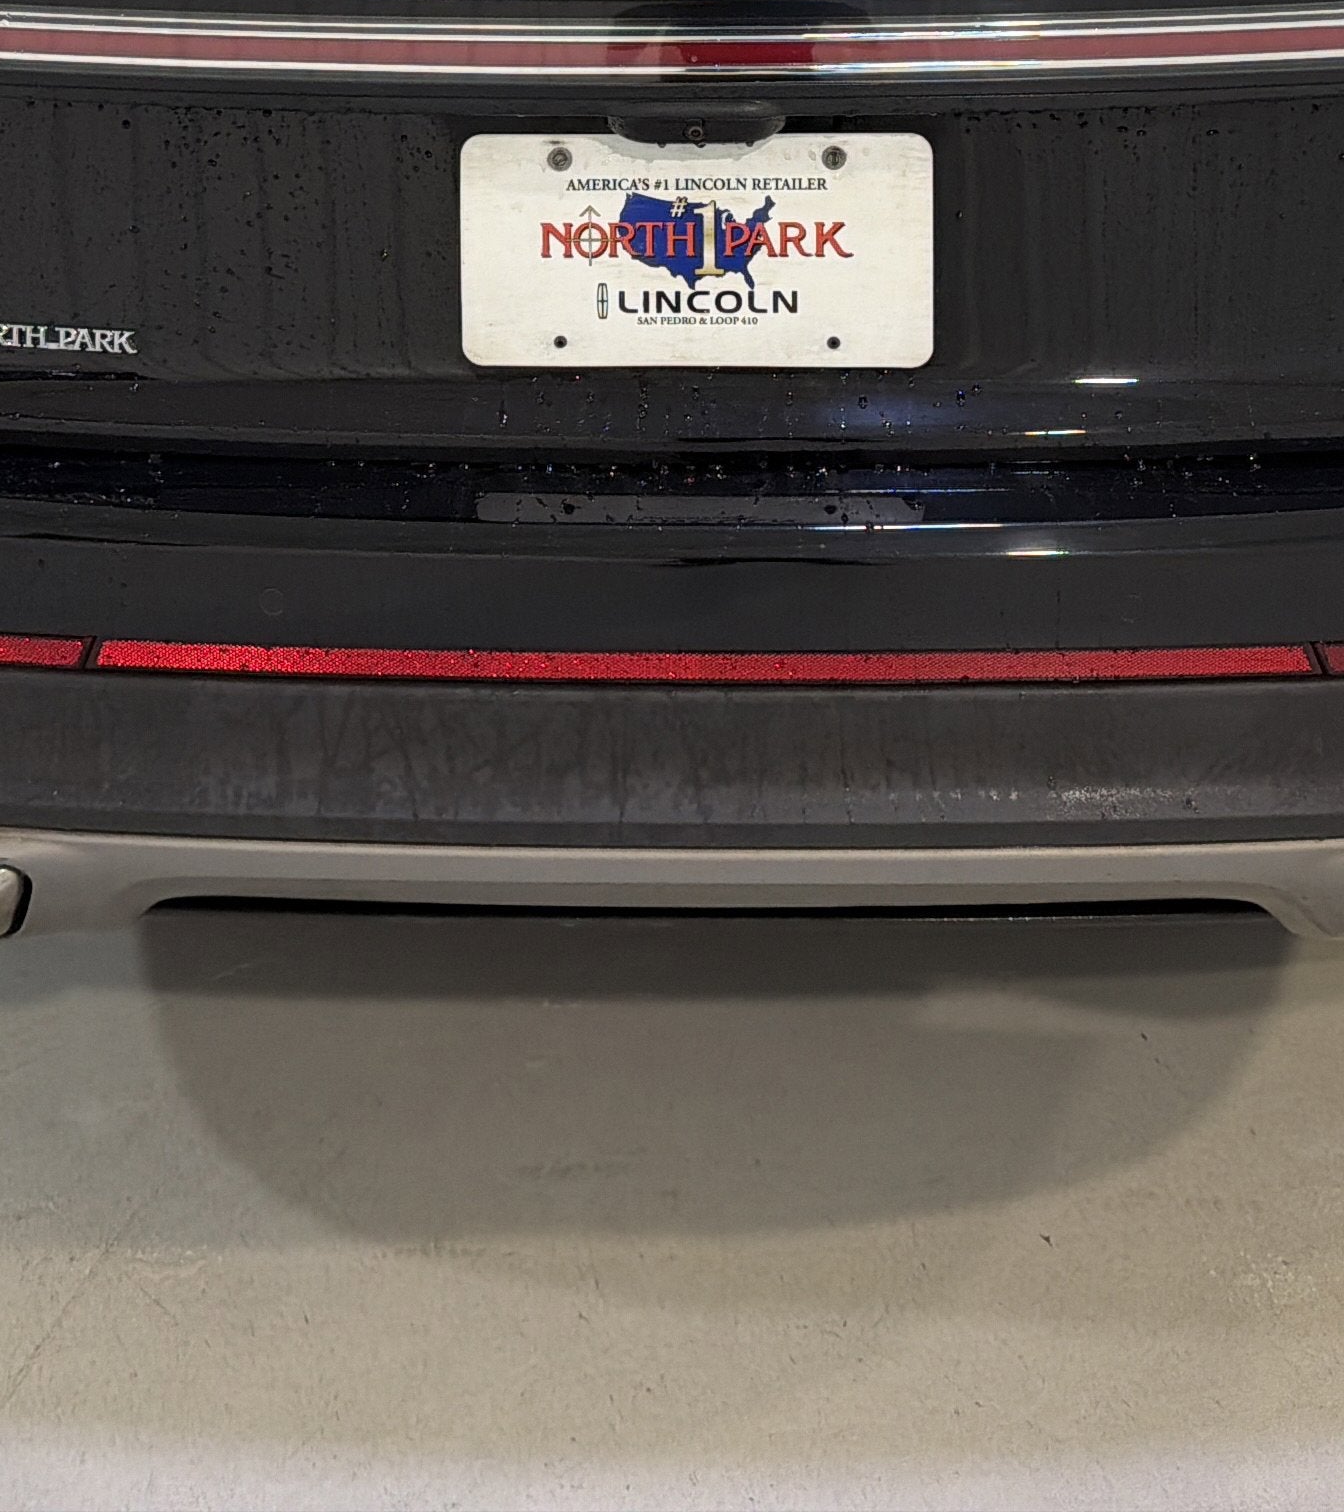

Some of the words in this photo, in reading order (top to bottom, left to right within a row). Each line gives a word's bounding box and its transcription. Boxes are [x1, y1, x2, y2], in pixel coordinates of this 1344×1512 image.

[566, 177, 650, 191] AMERICA'S
[654, 178, 669, 191] #1
[675, 177, 748, 191] LINCOLN
[752, 177, 828, 191] RETAILER
[540, 221, 696, 259] NORTH
[723, 221, 854, 259] PARK
[618, 290, 798, 314] LINCOLN
[637, 316, 657, 325] SAN
[660, 316, 697, 325] PEDRO
[709, 316, 740, 325] LOOP
[741, 316, 759, 326] 410
[55, 326, 139, 355] PARK
